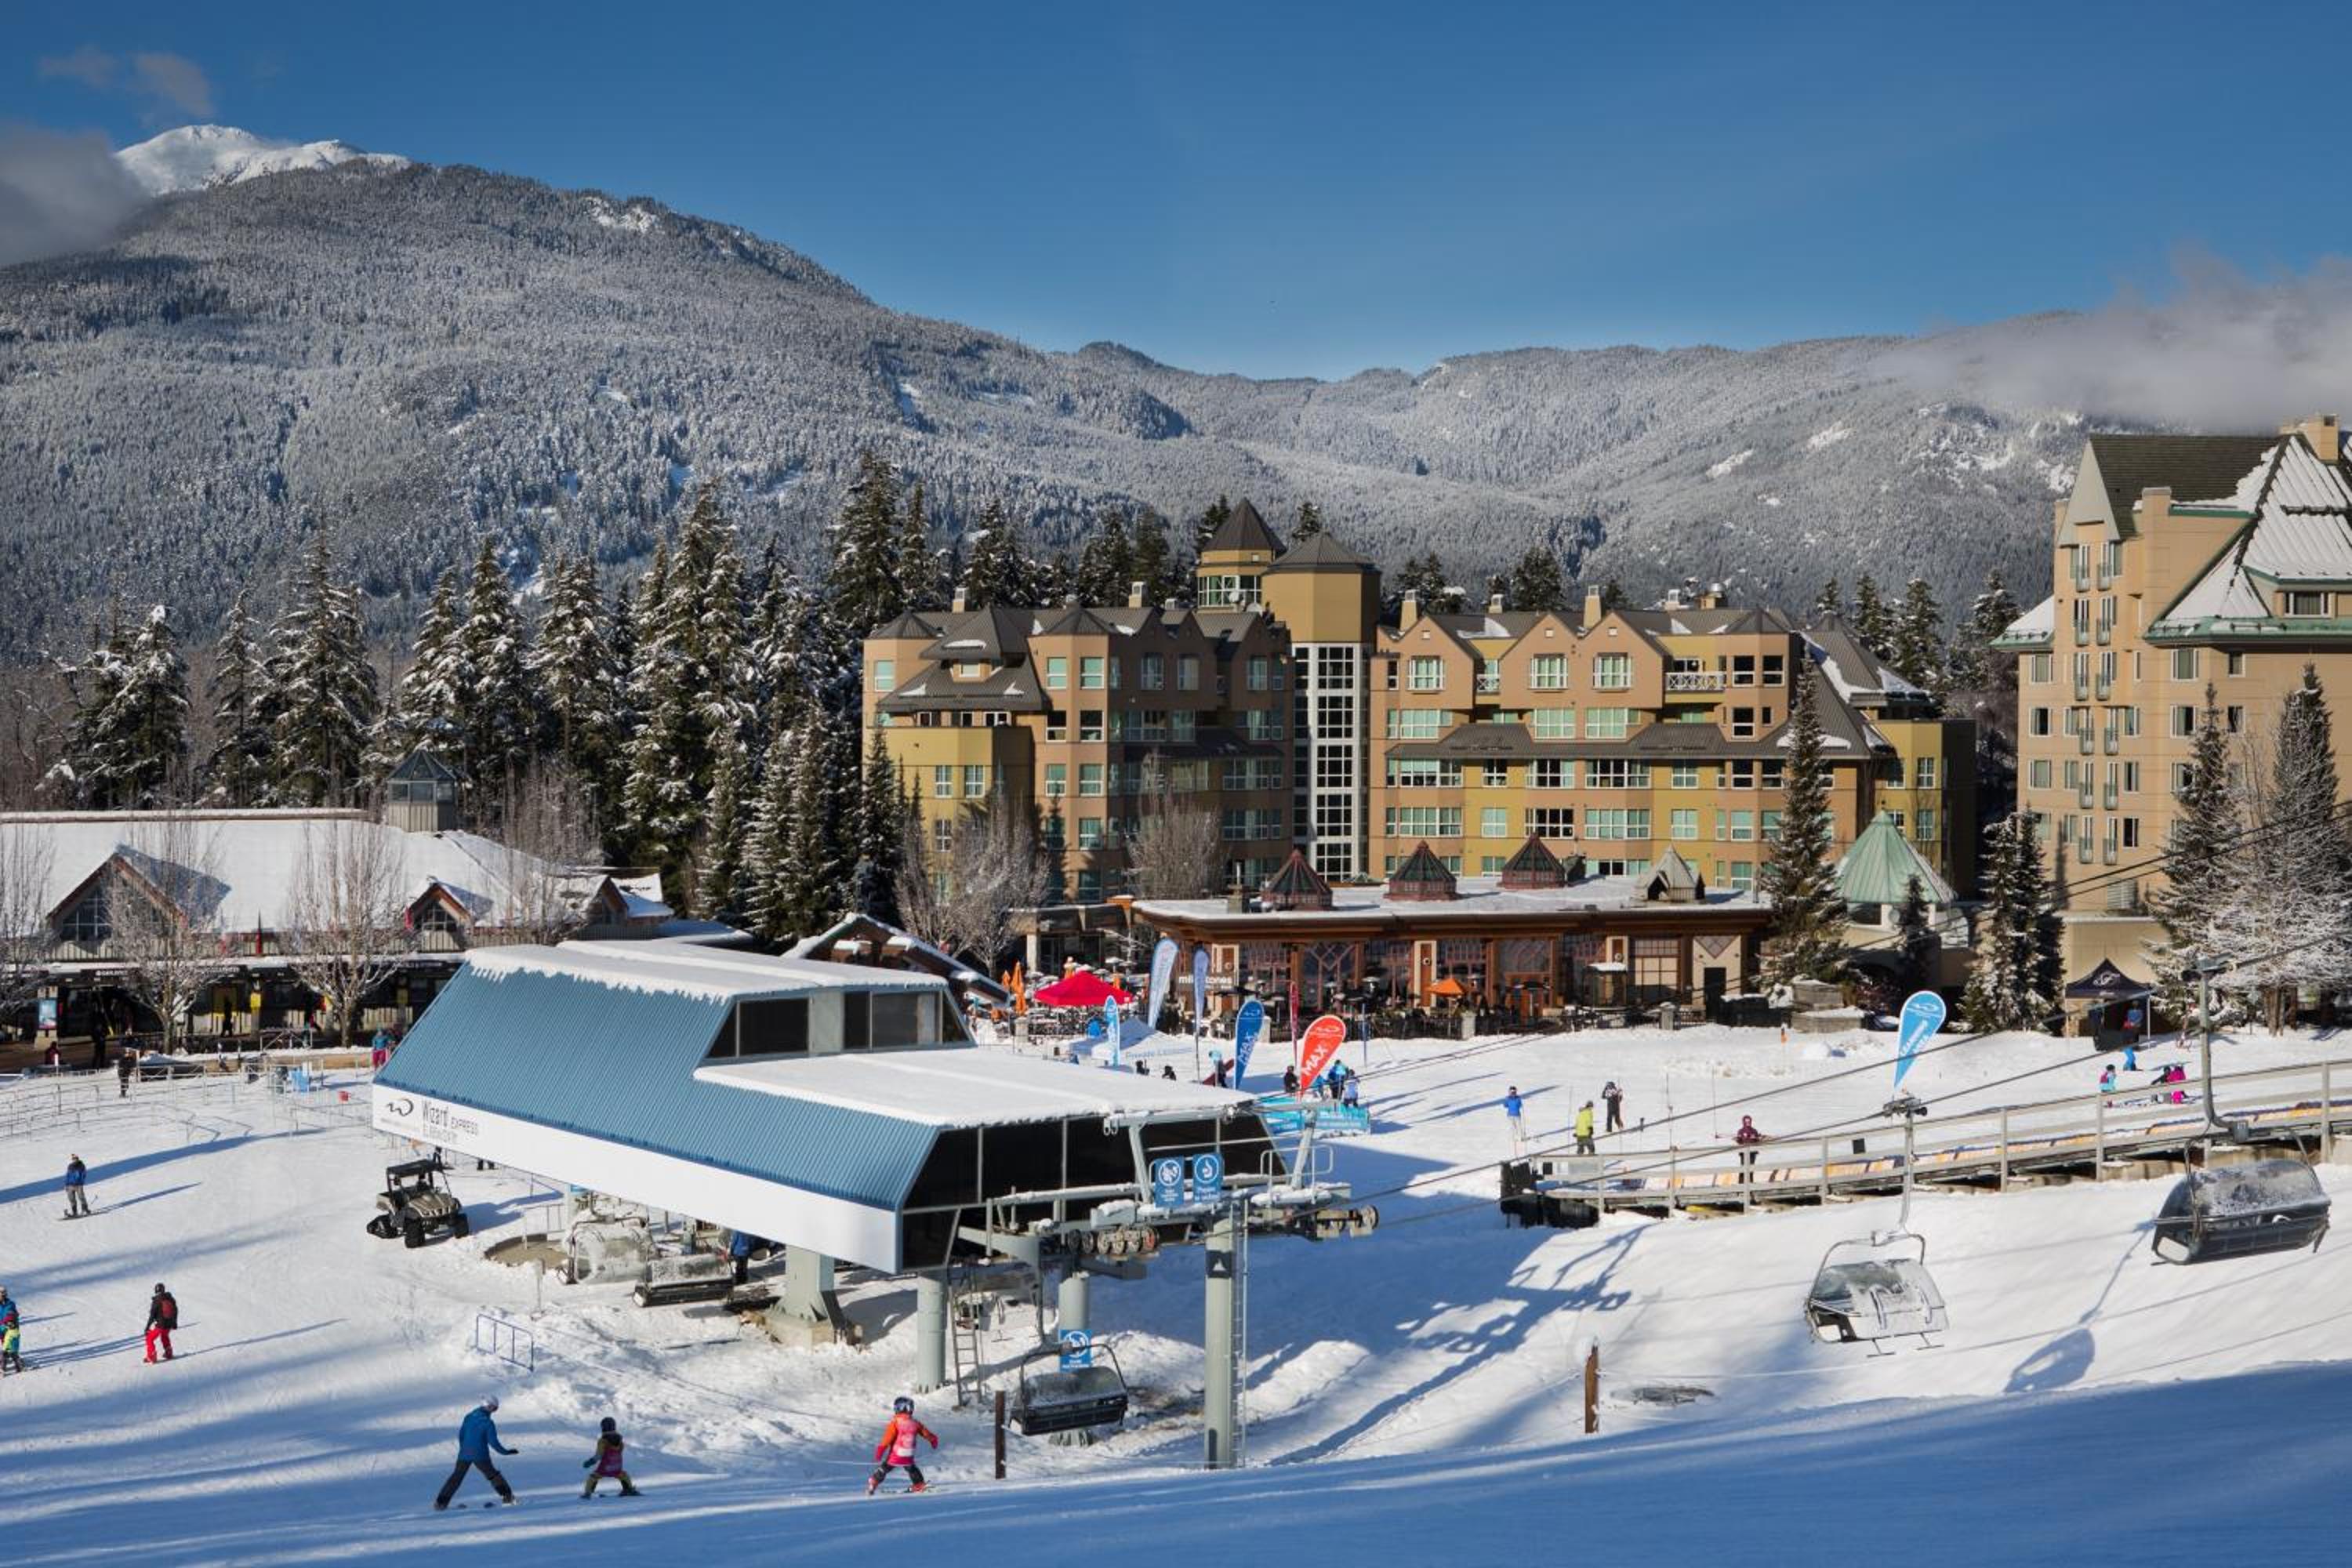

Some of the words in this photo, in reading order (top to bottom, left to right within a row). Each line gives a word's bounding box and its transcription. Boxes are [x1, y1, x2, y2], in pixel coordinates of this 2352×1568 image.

[1178, 974, 1233, 985] miltones
[1237, 1031, 1256, 1066] MAX
[1301, 1044, 1329, 1076] MAX
